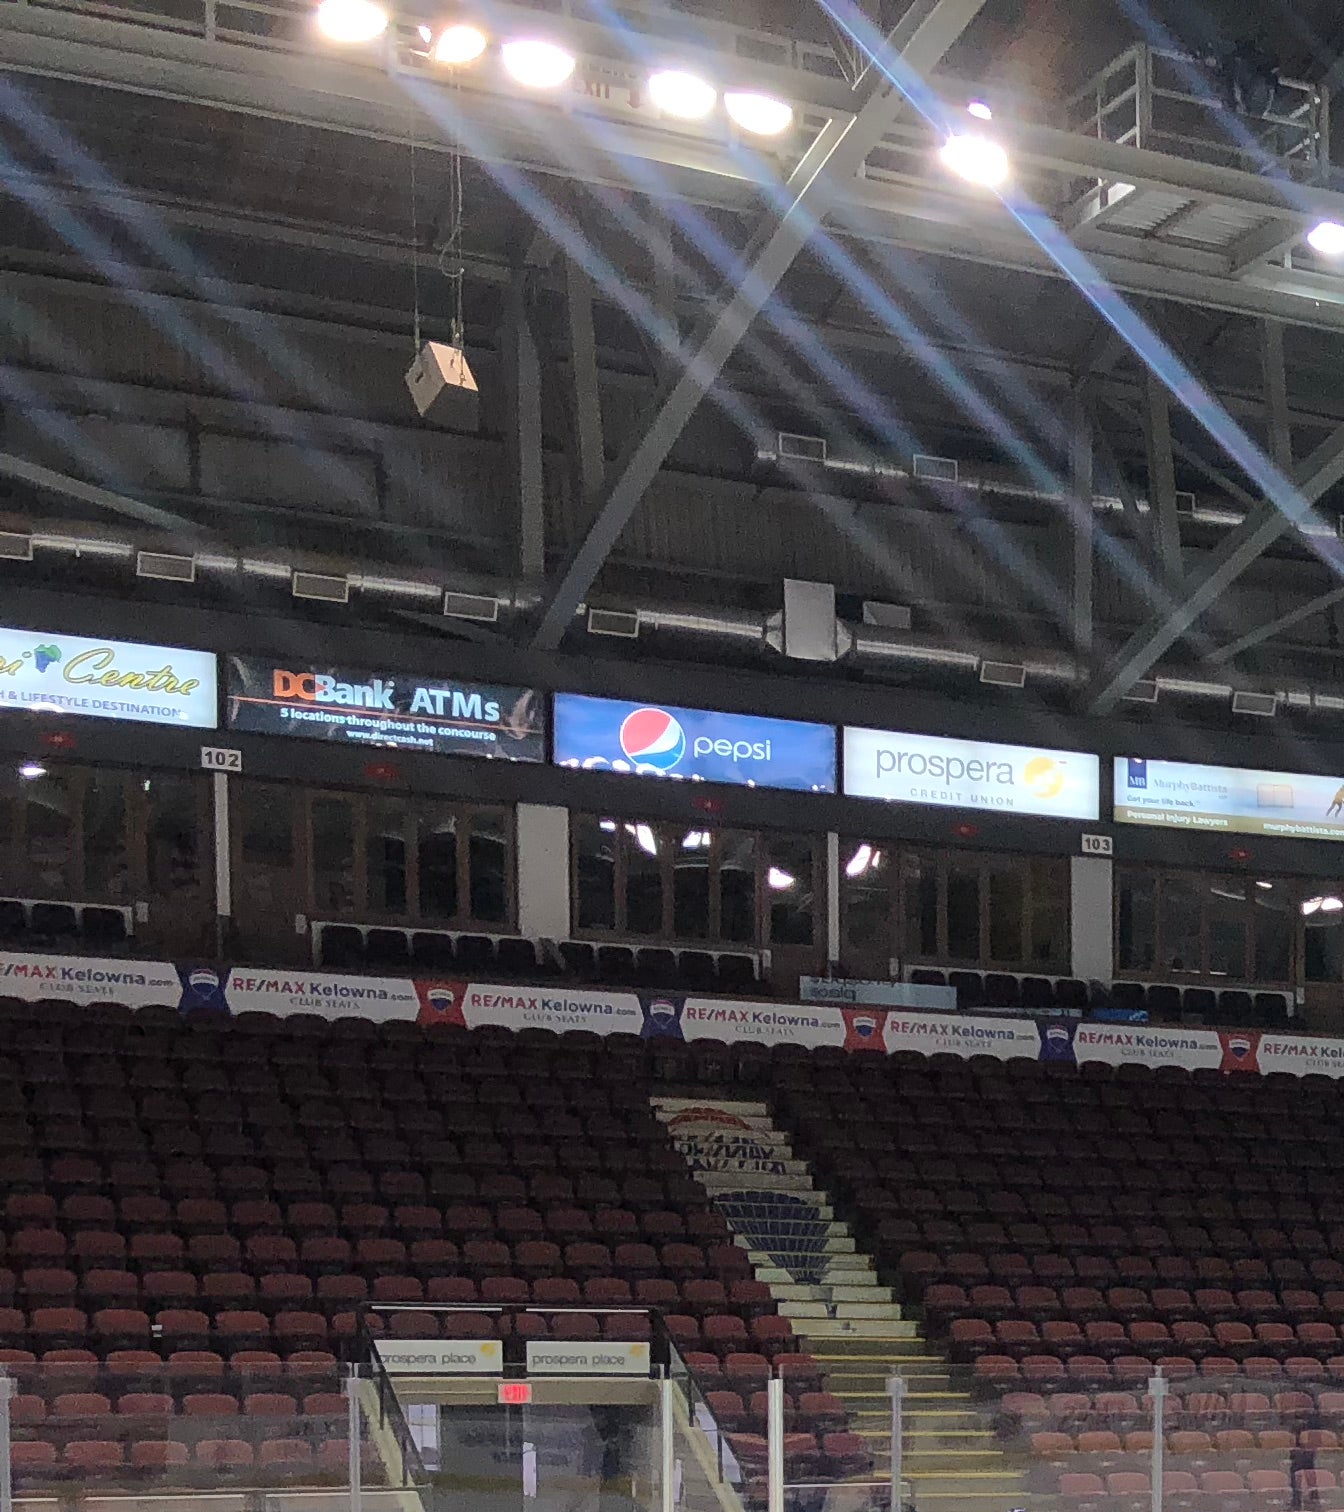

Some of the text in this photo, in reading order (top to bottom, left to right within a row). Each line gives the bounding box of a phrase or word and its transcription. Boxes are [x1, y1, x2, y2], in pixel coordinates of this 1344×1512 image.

[63, 648, 199, 696] Centre
[8, 690, 18, 701] &
[21, 692, 88, 708] LIFESTYLE
[273, 668, 500, 722] DCBank ATMs
[280, 707, 497, 742] 5 locations throughout the concourse
[694, 735, 771, 763] pepsi
[204, 751, 240, 768] 102
[876, 745, 1015, 788] prospera
[910, 787, 1014, 807] CREDIT UNION
[1084, 837, 1111, 852] 103
[233, 978, 306, 995] RE/MAX
[471, 993, 538, 1010] RE/MAX
[686, 1007, 749, 1023] RE/MAX
[891, 1021, 949, 1037] RE/MAX
[1079, 1031, 1133, 1047] RE/MAX
[1264, 1043, 1318, 1058] RE/MAX
[441, 1352, 477, 1366] place
[532, 1352, 625, 1367] prospera place
